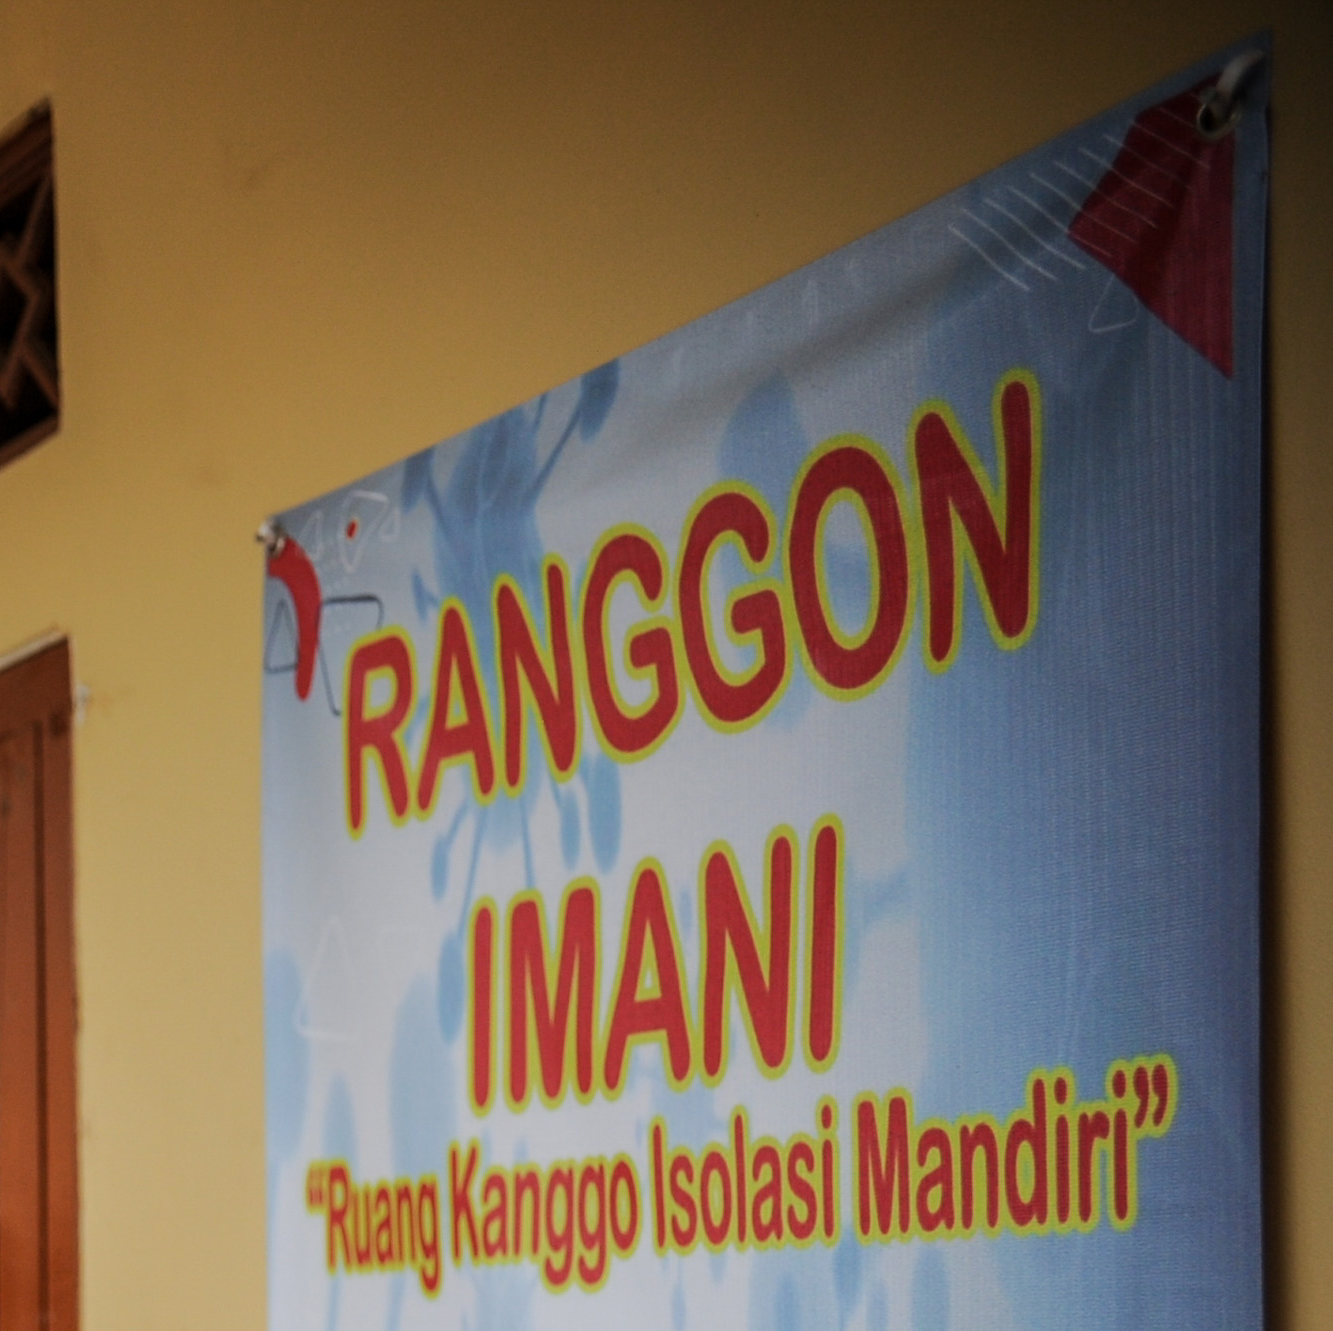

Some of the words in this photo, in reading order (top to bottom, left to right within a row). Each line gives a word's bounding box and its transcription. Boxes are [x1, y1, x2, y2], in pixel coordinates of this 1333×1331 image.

[342, 373, 1036, 836] RANGGON
[467, 819, 842, 1112] IMANI
[449, 1134, 641, 1292] Kanggo
[650, 1095, 838, 1252] Isolasi
